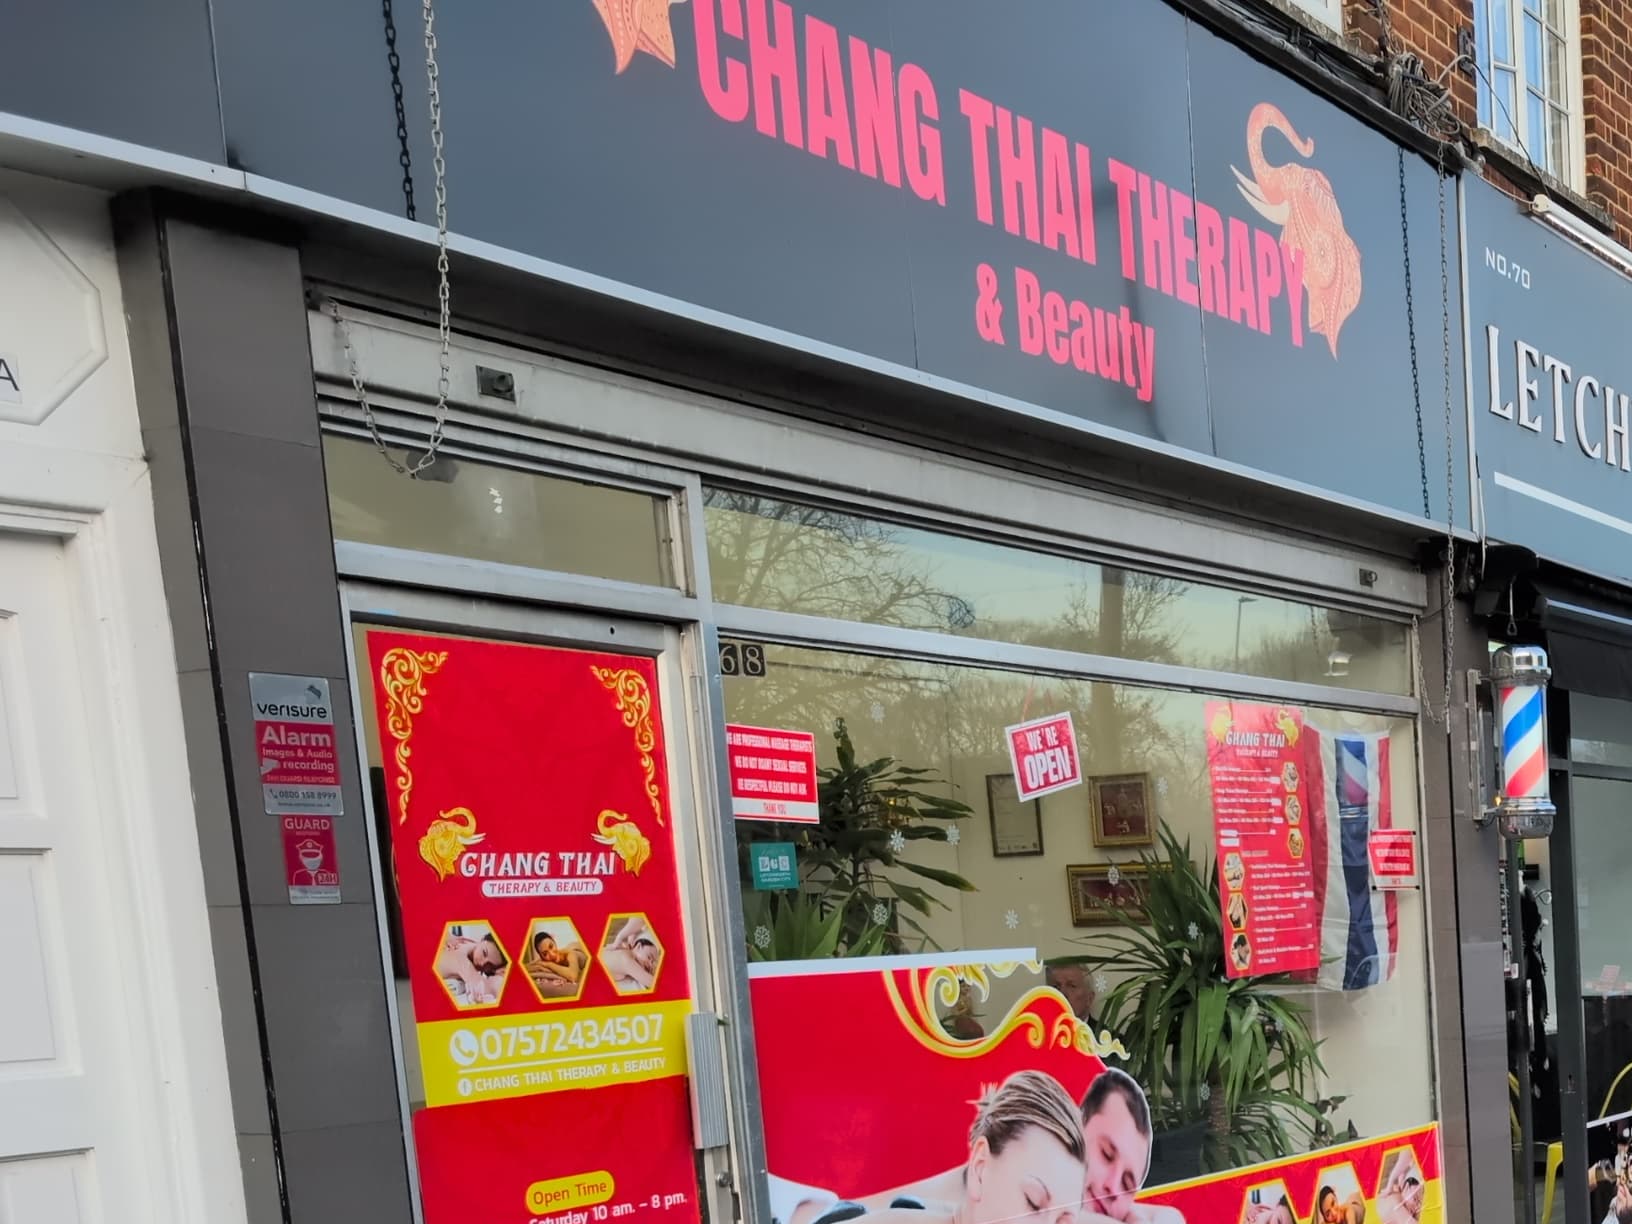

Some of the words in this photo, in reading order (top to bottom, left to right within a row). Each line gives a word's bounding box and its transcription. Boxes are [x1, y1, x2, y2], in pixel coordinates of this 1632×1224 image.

[693, 0, 946, 207] CHANG
[959, 87, 1097, 266] THAI
[1108, 157, 1305, 348] THERAPY
[1485, 246, 1531, 289] NO.70
[975, 262, 1005, 345] &
[1015, 265, 1156, 402] Beauty
[720, 645, 762, 675] 68
[257, 703, 327, 719] verisure
[263, 725, 331, 747] Alarm
[1026, 725, 1059, 751] WE'RE
[1226, 731, 1260, 747] CHANG
[1263, 733, 1286, 748] THAI
[263, 747, 295, 759] Images
[307, 749, 333, 759] Audio
[283, 759, 334, 774] recording
[1024, 745, 1073, 790] OPEN
[284, 817, 330, 830] GUARD
[460, 852, 550, 877] CHANG
[559, 852, 616, 876] THAI
[489, 882, 541, 895] THERAPY
[543, 883, 551, 893] &
[556, 881, 597, 893] BEAUTY
[480, 1013, 664, 1061] 07572434507
[475, 1073, 520, 1092] CHANG
[524, 1071, 553, 1087] THAI
[557, 1063, 607, 1082] THERAPY
[612, 1063, 620, 1074] &
[624, 1057, 666, 1074] BEAUTY
[533, 1188, 570, 1207] Open
[575, 1180, 607, 1197] Time
[592, 1204, 608, 1221] 10
[612, 1202, 636, 1217] am.
[651, 1194, 661, 1209] 8
[664, 1191, 688, 1210] pm.
